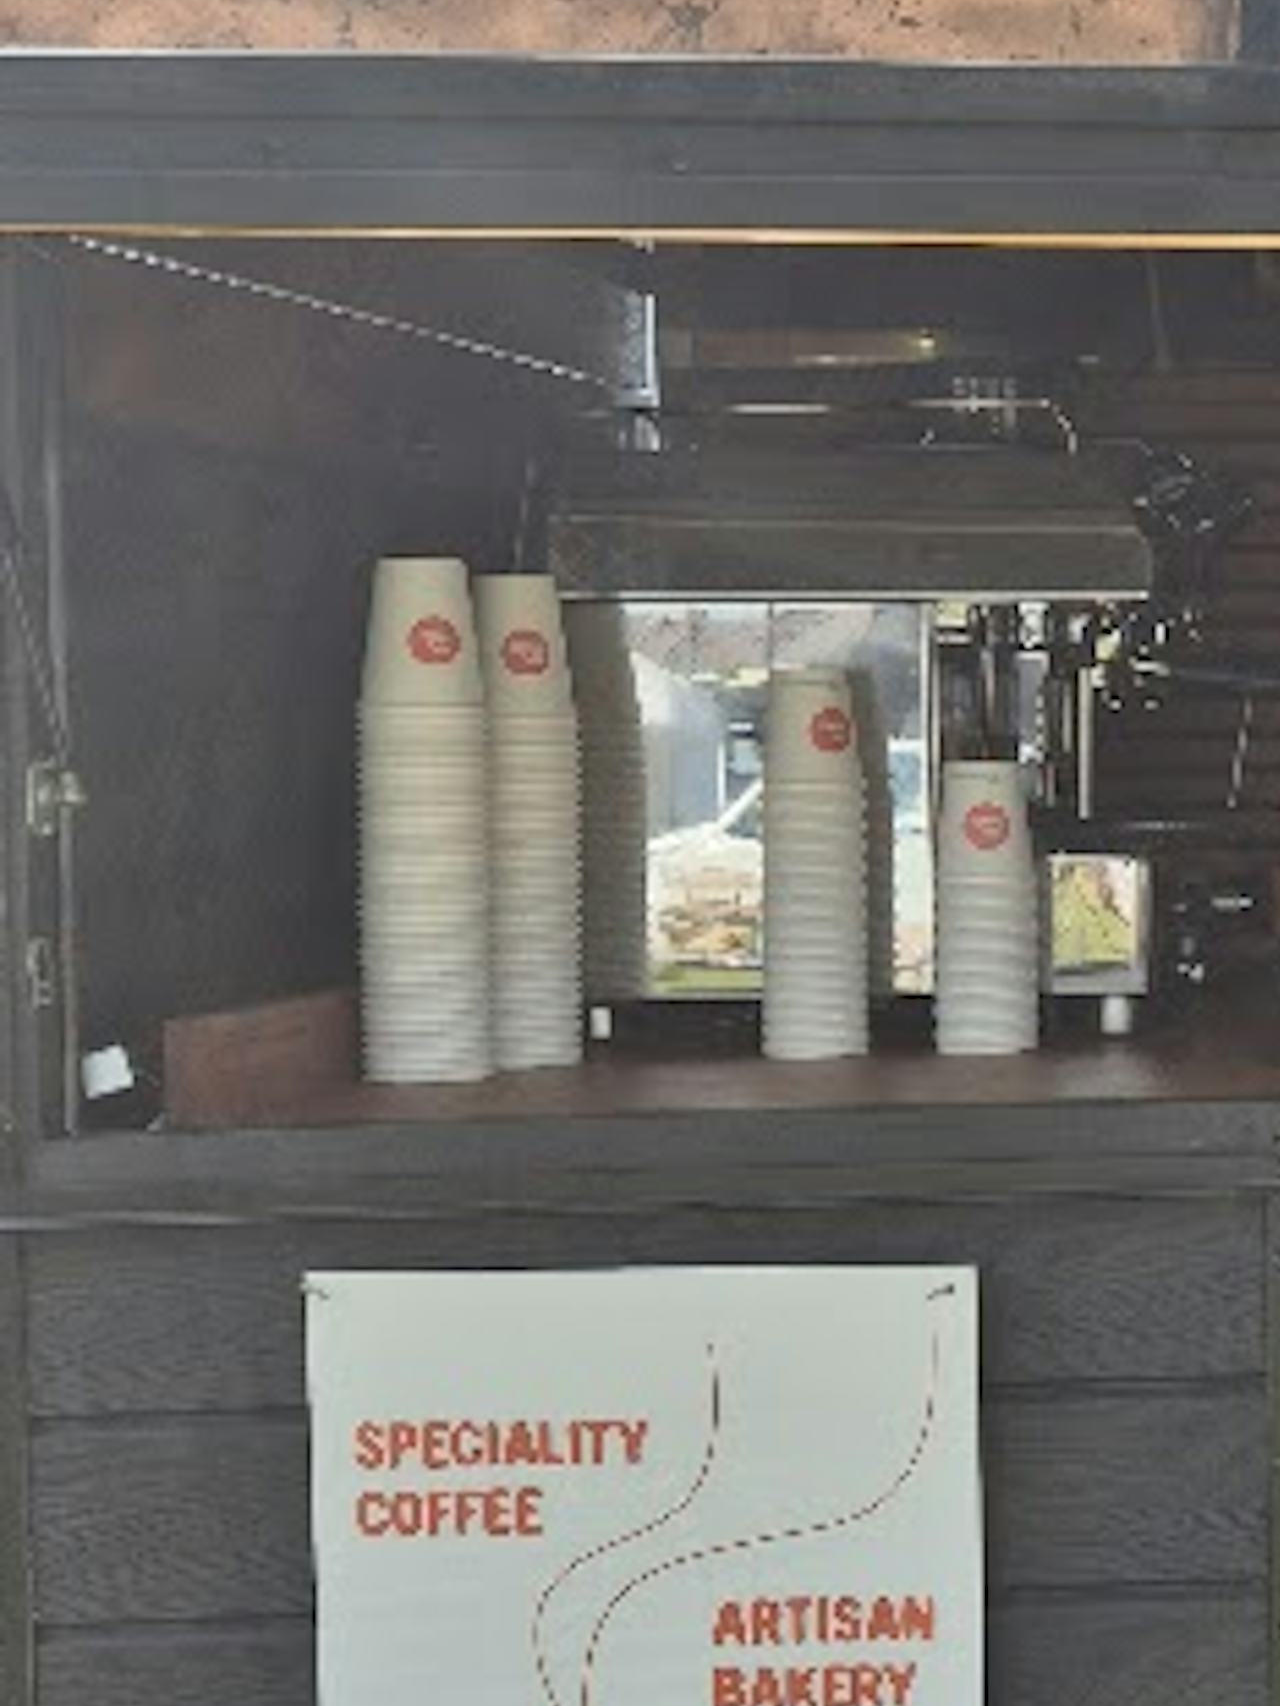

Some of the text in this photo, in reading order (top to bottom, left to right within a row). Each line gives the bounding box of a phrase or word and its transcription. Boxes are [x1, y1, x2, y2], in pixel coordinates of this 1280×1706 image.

[356, 1420, 648, 1467] SPECIALITY
[356, 1487, 543, 1536] COFFEE
[712, 1597, 935, 1646] ARTISAN
